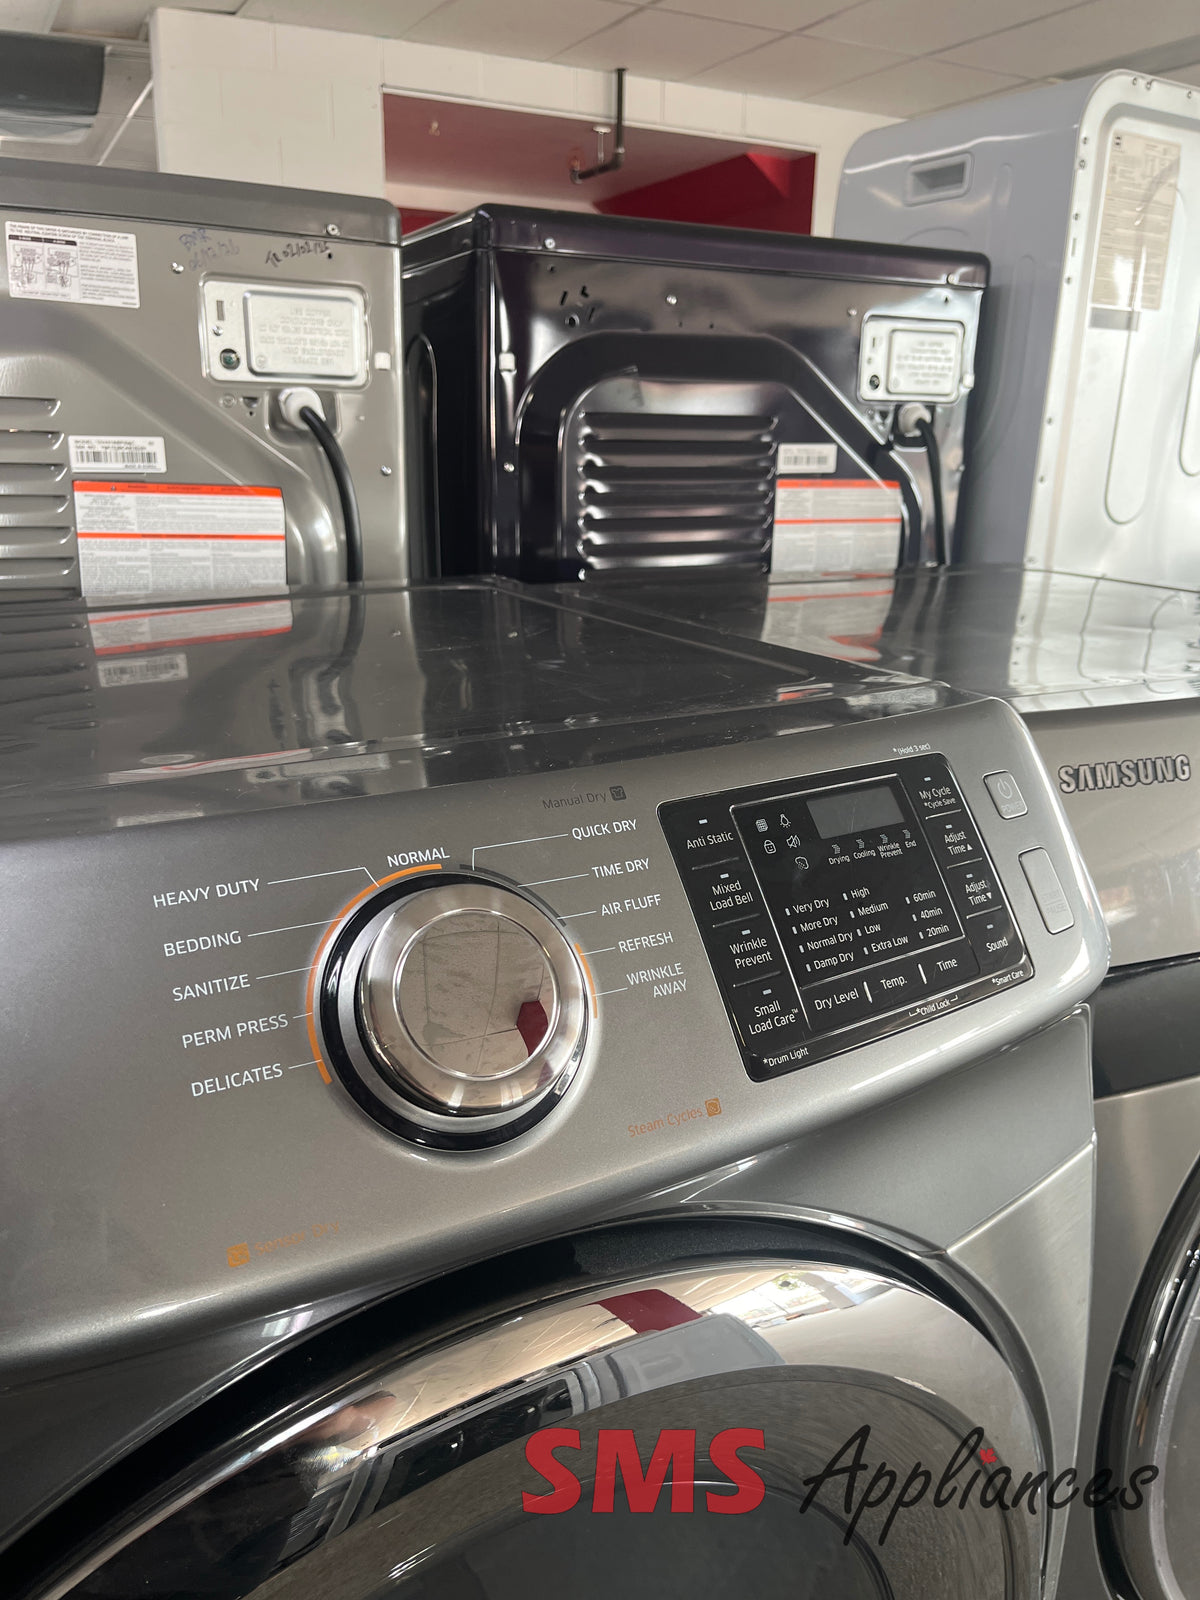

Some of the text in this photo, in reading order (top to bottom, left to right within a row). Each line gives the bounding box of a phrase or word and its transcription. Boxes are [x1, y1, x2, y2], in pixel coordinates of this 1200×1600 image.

[1058, 754, 1191, 794] SAMSUNG
[542, 790, 607, 809] Manual Dry
[918, 785, 952, 800] My Cycle
[942, 796, 957, 806] Save
[571, 818, 638, 841] QUICK DRY
[944, 830, 967, 845] Adjust
[686, 831, 734, 850] Anti Static
[877, 841, 901, 853] Wrinkle
[904, 839, 917, 849] End
[387, 847, 451, 868] NORMAL
[828, 853, 851, 866] Drying
[853, 847, 877, 861] Cooling
[879, 847, 904, 860] Prevent
[947, 844, 967, 857] Time
[591, 857, 650, 879] TIME DRY
[153, 878, 261, 908] HEAVY DUTY
[711, 880, 742, 896] Mixed
[850, 886, 870, 899] High
[912, 888, 937, 903] 60min
[965, 879, 988, 894] Adjust
[601, 893, 662, 917] AIR FLUFF
[709, 891, 754, 911] Load Bell
[793, 897, 830, 915] Very Dry
[968, 893, 988, 906] Time
[857, 901, 889, 917] Medium
[920, 906, 943, 920] 40min
[800, 914, 838, 933] More Dry
[864, 922, 882, 935] Low
[926, 923, 950, 938] 20min
[163, 930, 243, 957] BEDDING
[618, 931, 674, 953] REFRESH
[729, 937, 768, 955] Wrinkle
[806, 930, 854, 952] Normal Dry
[871, 934, 909, 953] Extra Low
[985, 936, 1009, 953] Sound
[734, 950, 773, 969] Prevent
[813, 950, 855, 970] Damp Dry
[936, 957, 958, 972] Time
[626, 962, 684, 986] WRINKLE
[879, 974, 908, 990] Temp.
[1010, 969, 1024, 981] Care
[172, 973, 251, 1002] SANITIZE
[653, 979, 688, 998] AWAY
[814, 987, 860, 1012] Dry Level
[935, 998, 951, 1011] Lock
[754, 1000, 782, 1018] Small
[181, 1013, 289, 1049] PERM PRESS
[748, 1019, 774, 1036] Load
[789, 1046, 810, 1060] Light
[190, 1063, 284, 1097] DELICATES
[627, 1107, 703, 1139] Steam Cycles
[254, 1221, 340, 1256] Sensor Dry
